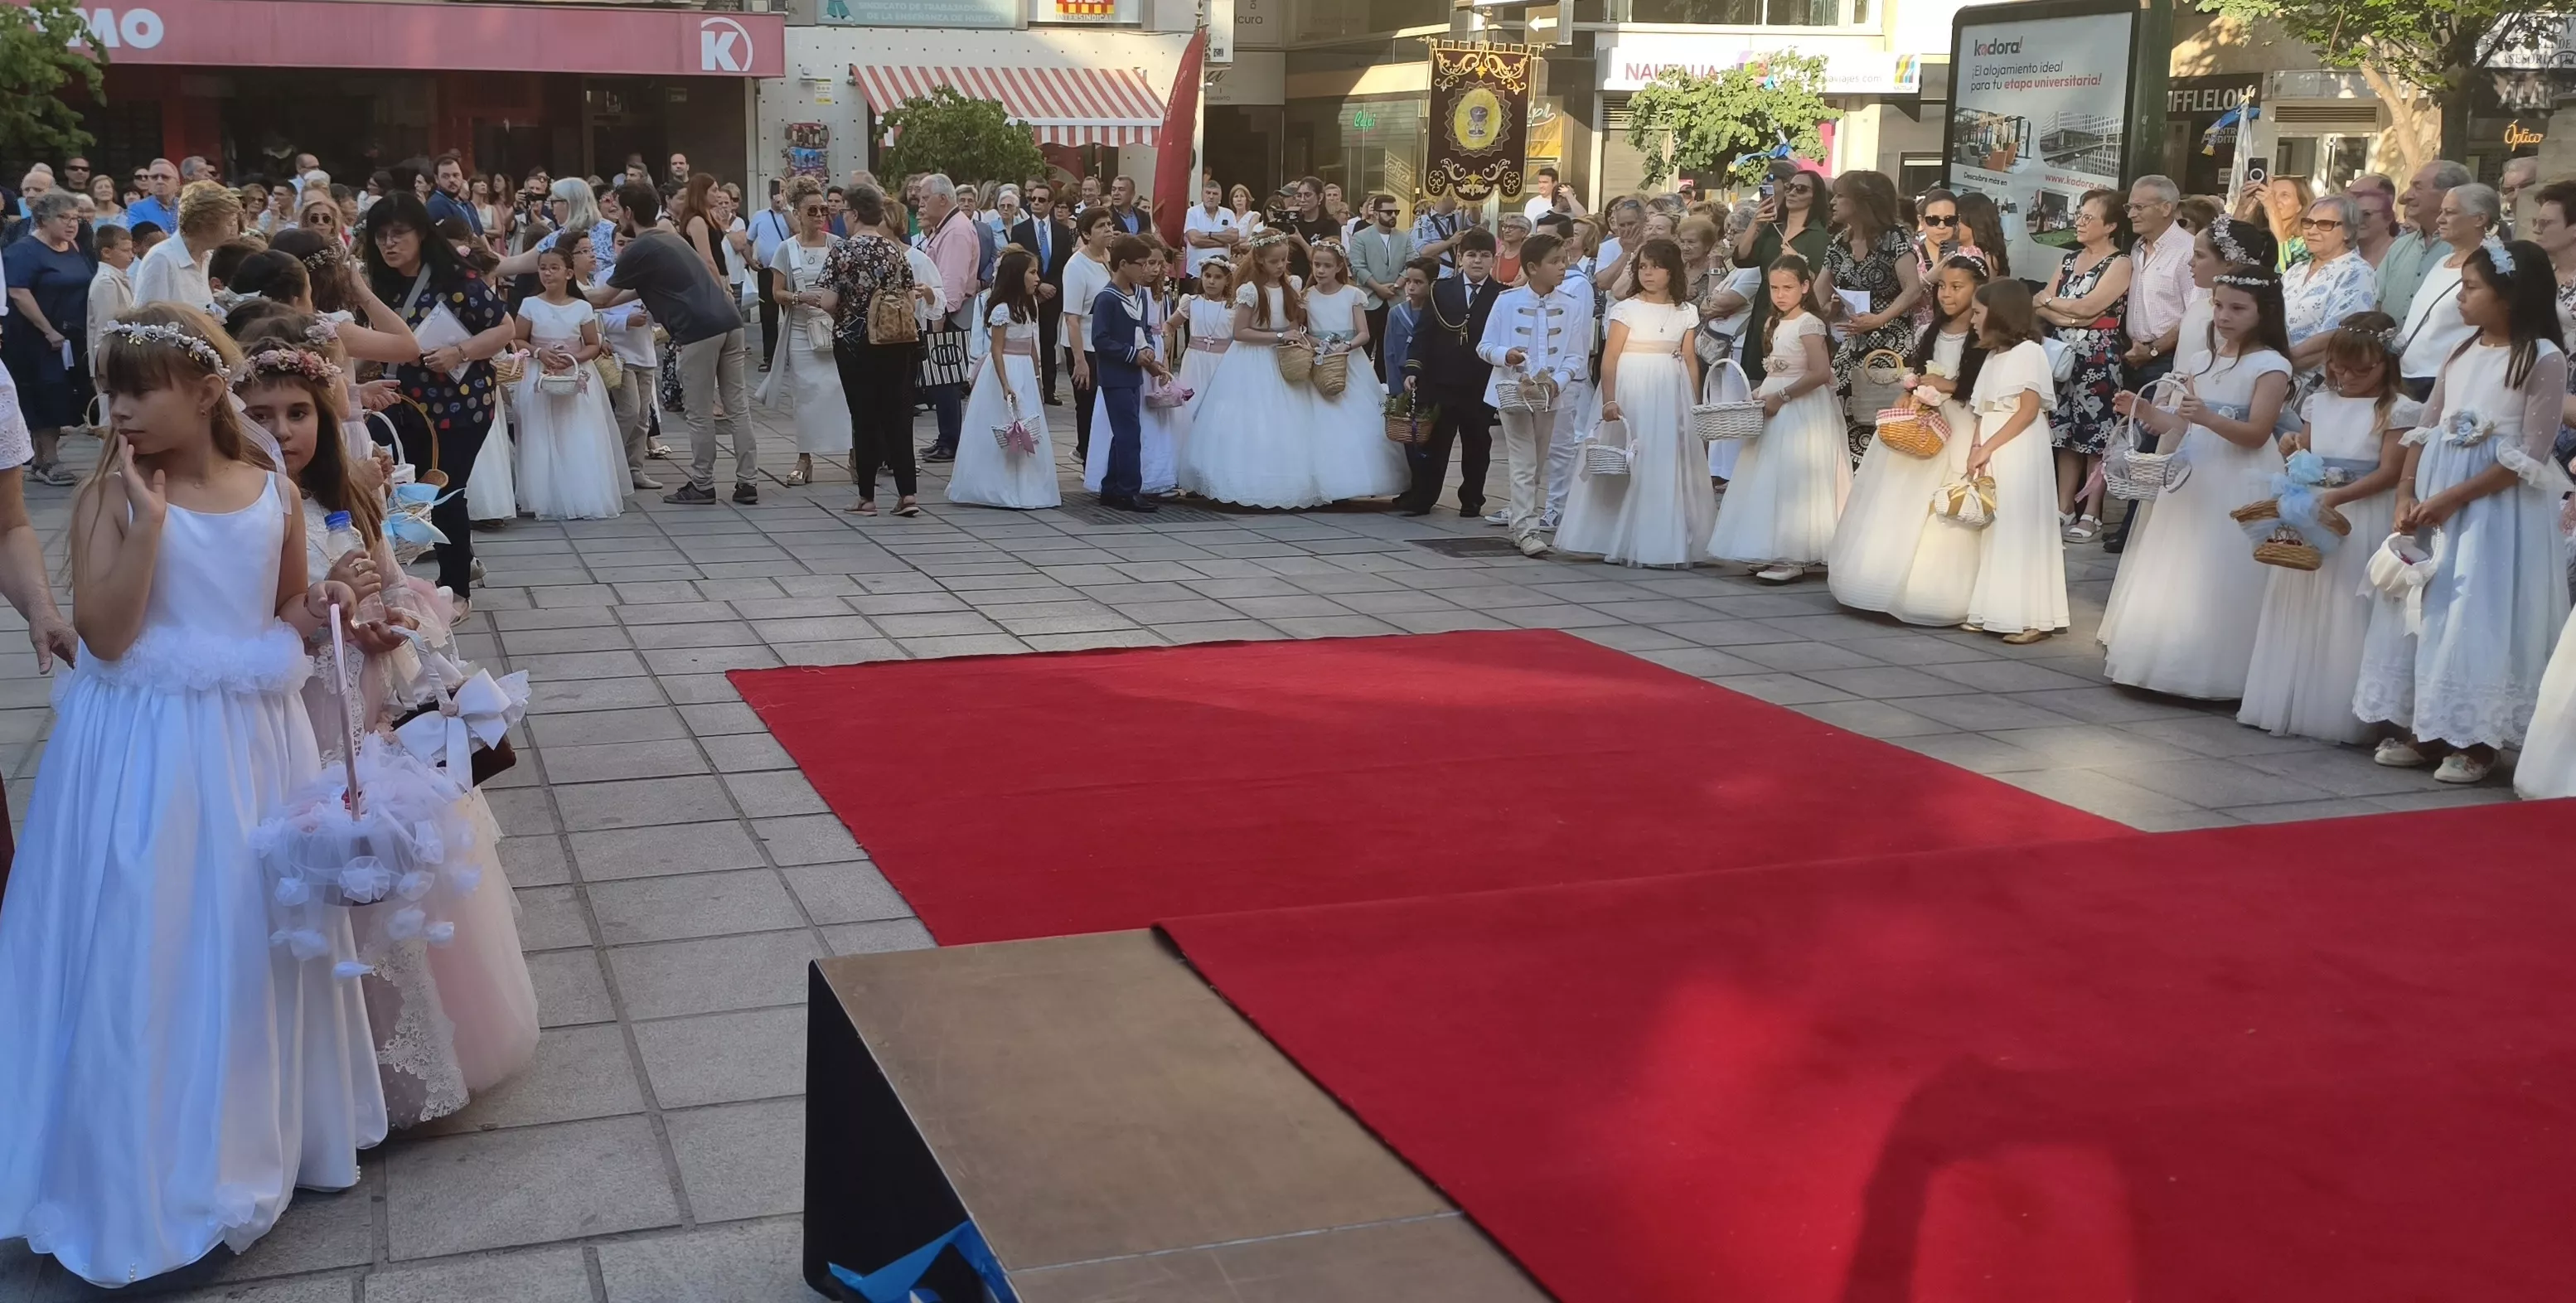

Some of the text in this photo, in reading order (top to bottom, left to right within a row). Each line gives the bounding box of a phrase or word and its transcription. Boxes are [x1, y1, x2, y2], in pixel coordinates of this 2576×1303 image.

[859, 2, 906, 12] SINDICATO
[909, 3, 921, 12] DE
[867, 12, 879, 20] DE
[882, 12, 893, 21] LA
[895, 12, 950, 22] ENSEÑANZA
[965, 14, 1001, 22] HUESCA
[701, 30, 741, 72] K
[2503, 53, 2555, 65] ASESOR
[1983, 62, 2038, 78] alojamiento
[2040, 61, 2064, 74] ideal
[1970, 73, 2103, 93] para tu etapa universitaria!
[2167, 88, 2248, 113] FFLELO
